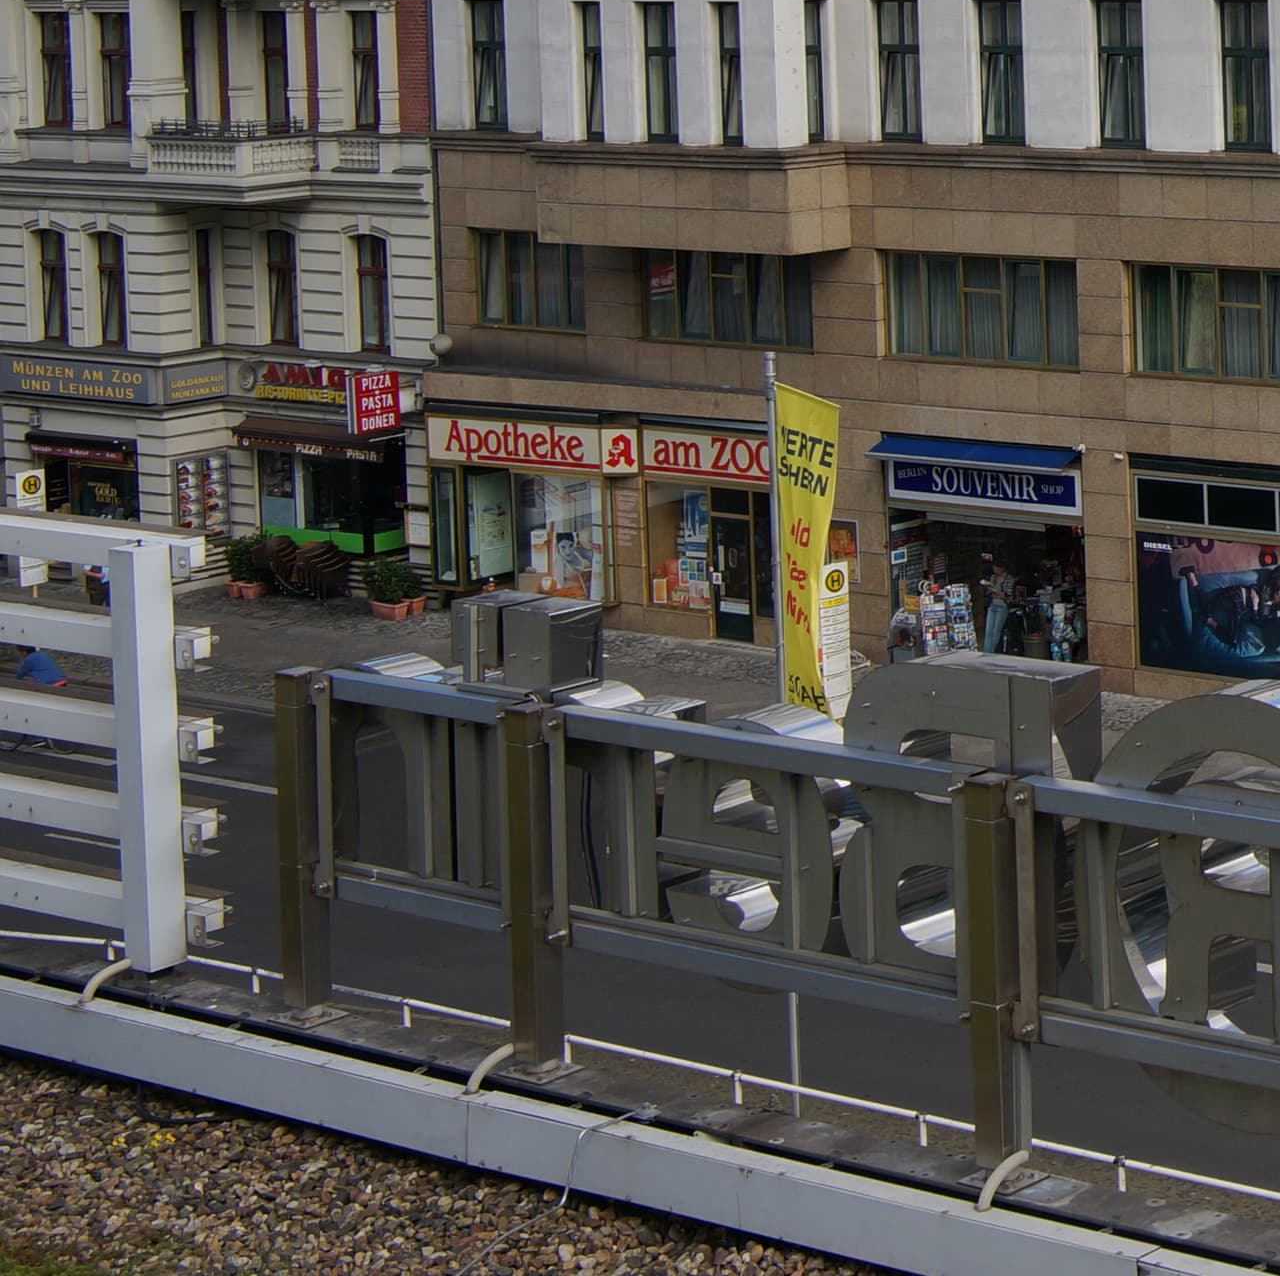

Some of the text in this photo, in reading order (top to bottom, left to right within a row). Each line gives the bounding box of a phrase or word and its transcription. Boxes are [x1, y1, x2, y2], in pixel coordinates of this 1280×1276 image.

[12, 360, 143, 385] MÜNZEN AM ZOO
[361, 374, 392, 391] PIZZA
[21, 379, 135, 400] UND LEIHHAUS
[361, 393, 394, 411] PASTA
[444, 419, 585, 462] Apotheke
[295, 443, 377, 461] PIZZA PASTA
[653, 438, 702, 469] am
[897, 465, 1064, 501] BERLIN SOUVENIR SHOP
[1143, 541, 1173, 551] DIESEL
